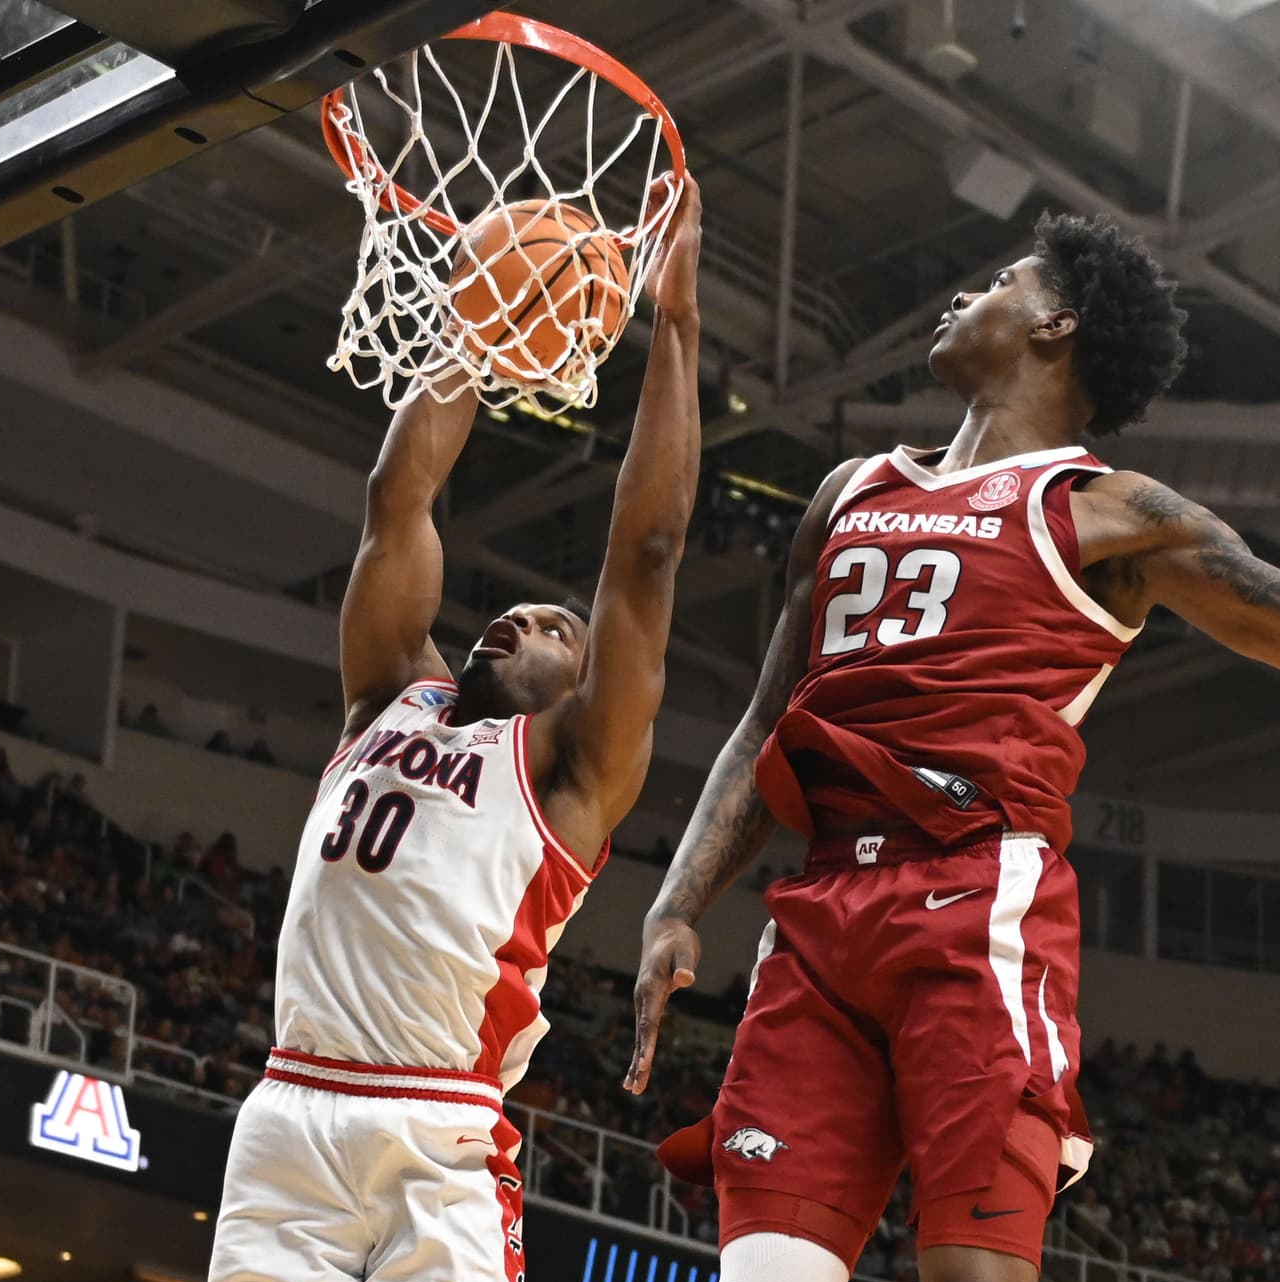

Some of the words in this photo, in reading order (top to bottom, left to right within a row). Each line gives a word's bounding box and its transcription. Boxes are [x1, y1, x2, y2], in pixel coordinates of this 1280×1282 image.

[830, 511, 982, 540] ARKANSAS
[820, 546, 962, 656] 23
[951, 781, 967, 796] 50
[321, 778, 416, 874] 30
[1095, 801, 1143, 846] 218
[858, 842, 879, 856] AR
